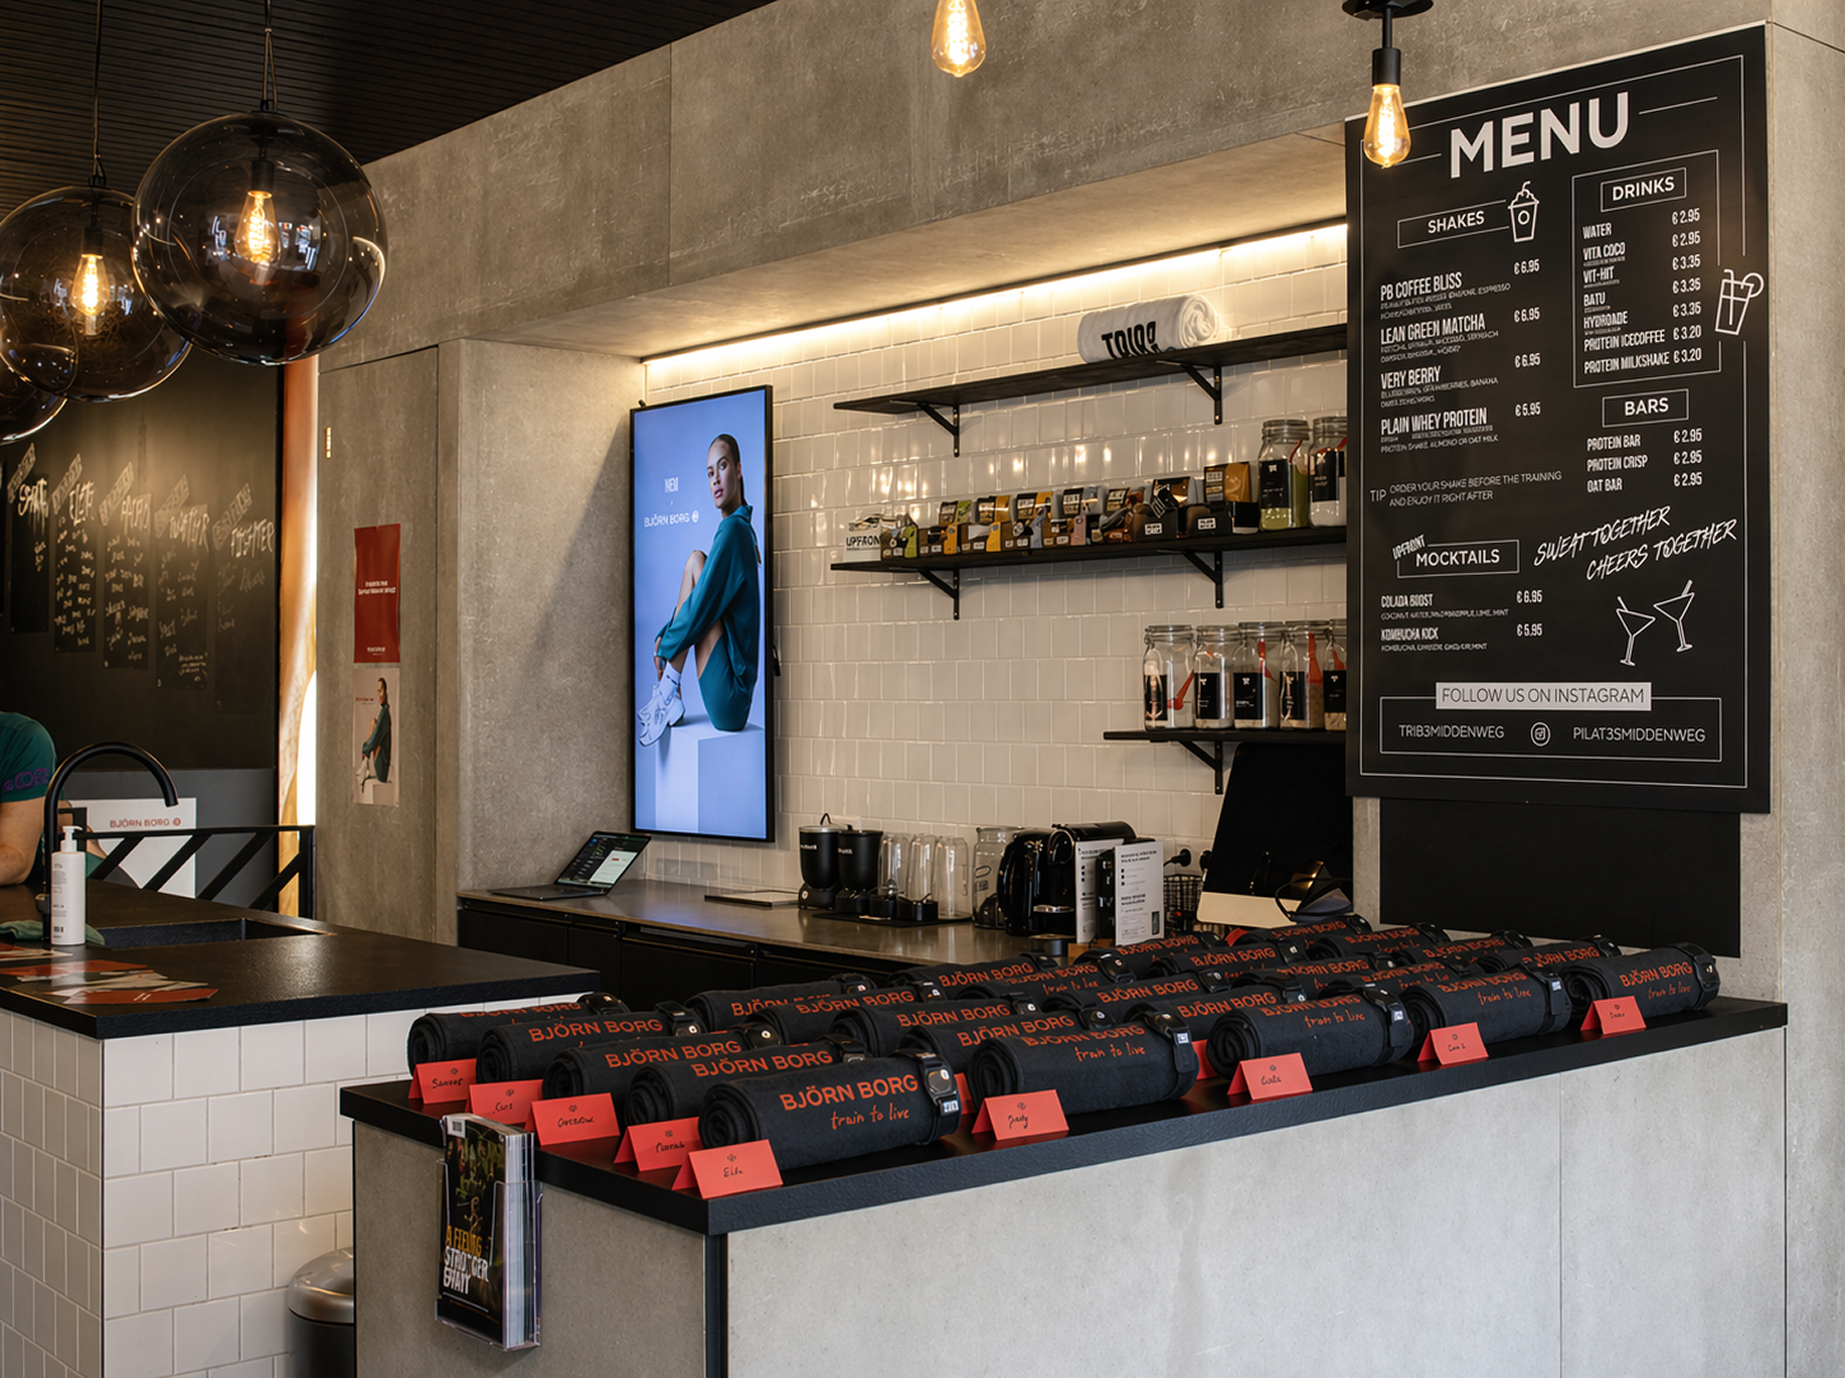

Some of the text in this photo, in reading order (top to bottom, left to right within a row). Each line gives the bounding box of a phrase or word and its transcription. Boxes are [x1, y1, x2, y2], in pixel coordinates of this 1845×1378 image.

[1450, 91, 1629, 179] MENU
[1612, 176, 1675, 201] DRINKS
[1427, 210, 1485, 233] SHAKES
[1582, 222, 1612, 239] WATER
[1380, 284, 1394, 301] PB
[1395, 276, 1432, 298] COFFEE
[1433, 271, 1463, 293] BLISS
[1380, 325, 1406, 345] LEAN
[1407, 319, 1440, 342] GREEN
[1442, 313, 1485, 336] MATCHA
[1584, 335, 1620, 352] PROTEIN
[1584, 358, 1620, 374] PROTEIN
[1380, 369, 1407, 390] VERY
[1408, 365, 1442, 387] BERRY
[1624, 396, 1669, 416] BARS
[1381, 416, 1410, 436] PLAIN
[1411, 412, 1442, 432] WHEY
[1443, 407, 1488, 429] PROTEIN
[1587, 435, 1622, 452] PROTEIN
[1623, 434, 1641, 448] BAR
[1587, 457, 1622, 472] PROTEIN
[1468, 475, 1502, 488] BEFORE
[1503, 473, 1519, 484] THE
[1521, 470, 1563, 482] TRAINING
[1587, 479, 1604, 493] OAT
[1605, 477, 1623, 492] BAR
[1370, 488, 1387, 502] TIP
[1466, 490, 1494, 501] AFTER
[846, 535, 880, 547] UPFRON
[1533, 505, 1671, 567] SWEAT TOGETHER
[1415, 548, 1500, 567] MOCKTAILS
[1586, 518, 1738, 581] CHEERS TOGETHER
[1441, 687, 1645, 704] FOLLOW US ON INSTAGRAM
[1573, 726, 1706, 743] PILAT3SMIDDENWEG
[109, 817, 170, 829] BJÖRN BORG
[938, 970, 989, 987] BJÖRN
[1619, 961, 1693, 987] BJÖRN BORG
[862, 990, 915, 1006] BORG
[1097, 978, 1199, 1004] BJÖRN BORG
[1177, 991, 1277, 1018] BJÖRN BORG
[896, 1004, 1011, 1027] BJÖRN BORG
[1020, 1015, 1075, 1034] BORG
[528, 1018, 663, 1042] BJÖRN BORG
[604, 1040, 742, 1068] BJÖRN BORG
[691, 1051, 834, 1077] BJÖRN BORG
[779, 1074, 919, 1111] BJÖRN BORG
[831, 1102, 910, 1130] train to live
